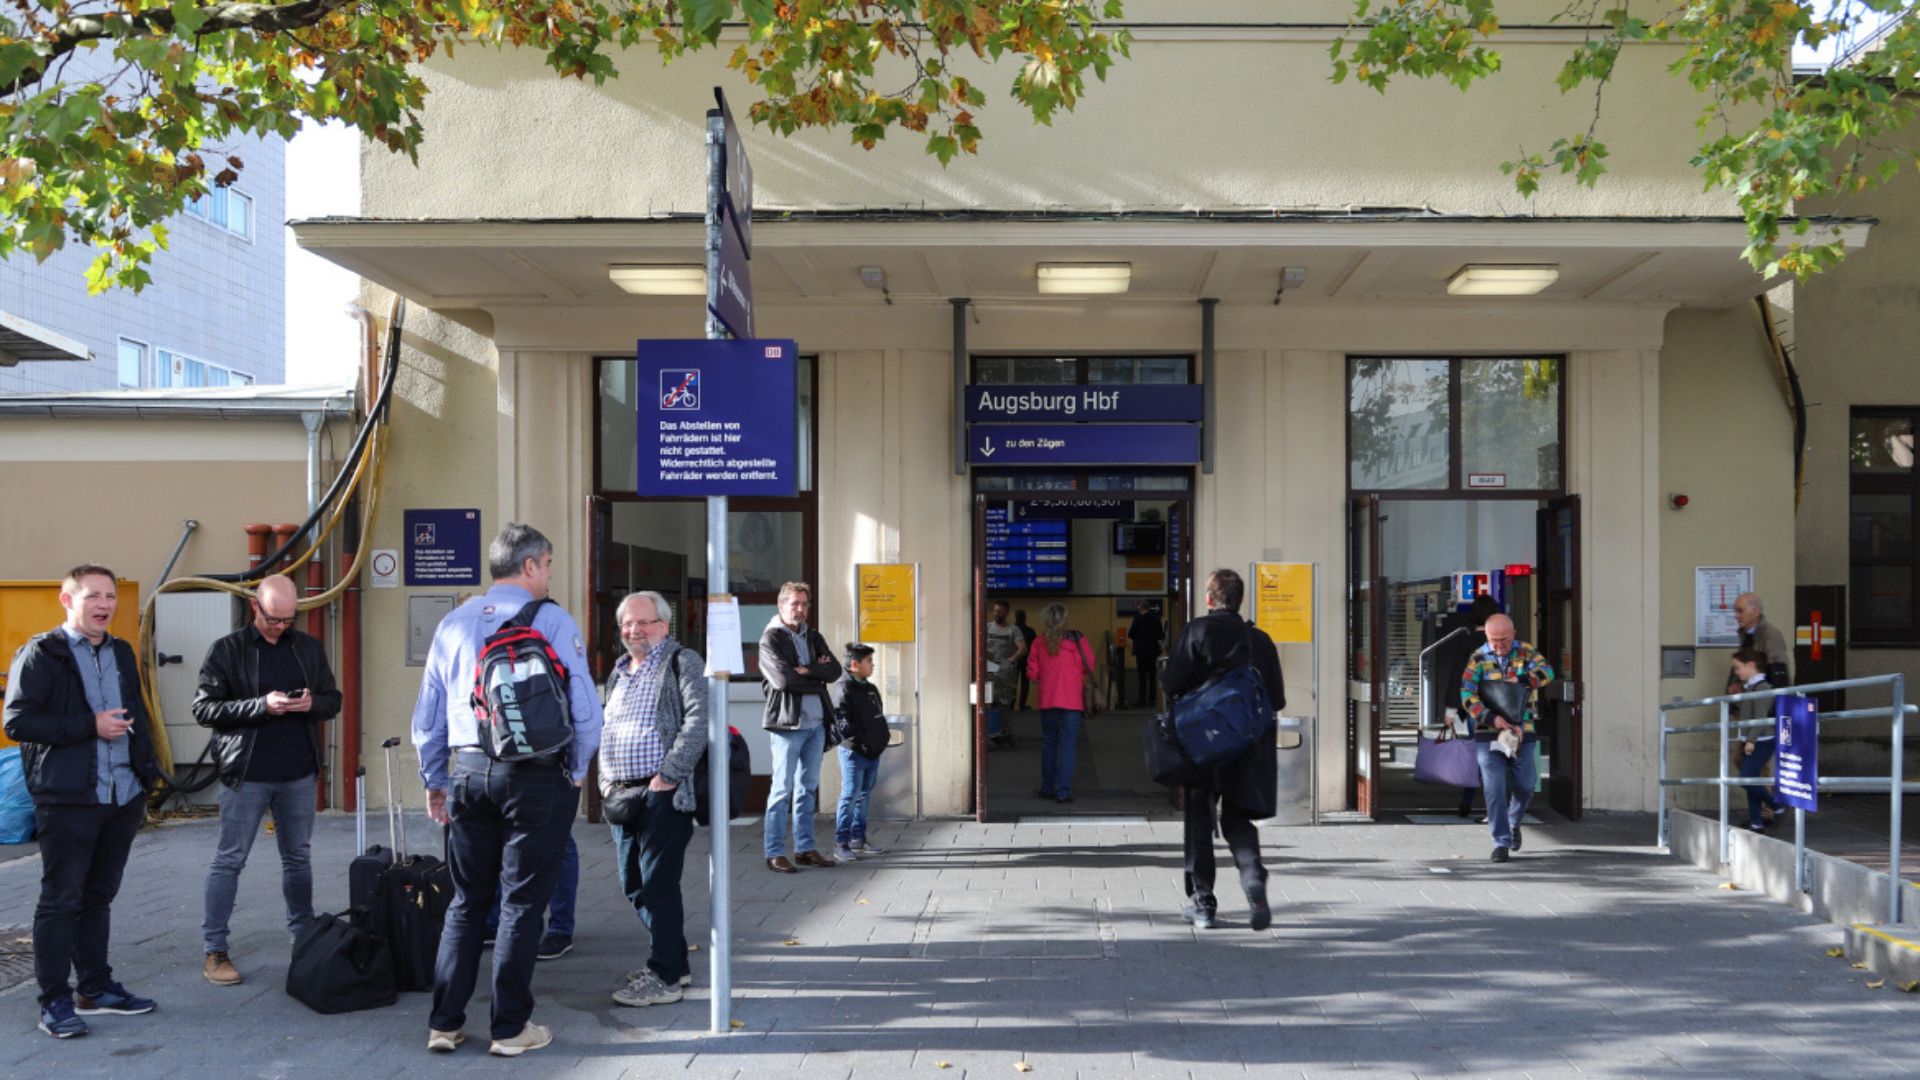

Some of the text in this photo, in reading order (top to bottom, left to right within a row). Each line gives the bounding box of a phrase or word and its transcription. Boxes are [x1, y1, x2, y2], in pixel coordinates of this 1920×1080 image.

[978, 391, 1120, 414] Augsburg Hbf
[659, 421, 740, 431] Das Abstellen von
[659, 433, 741, 443] Fahrrädern ist hier
[1005, 437, 1065, 449] zu den Zügen
[659, 446, 726, 457] nicht gestattet.
[659, 458, 777, 469] Widerrechtlich abgestellte
[659, 471, 778, 480] Fahrräder werden entfernt.
